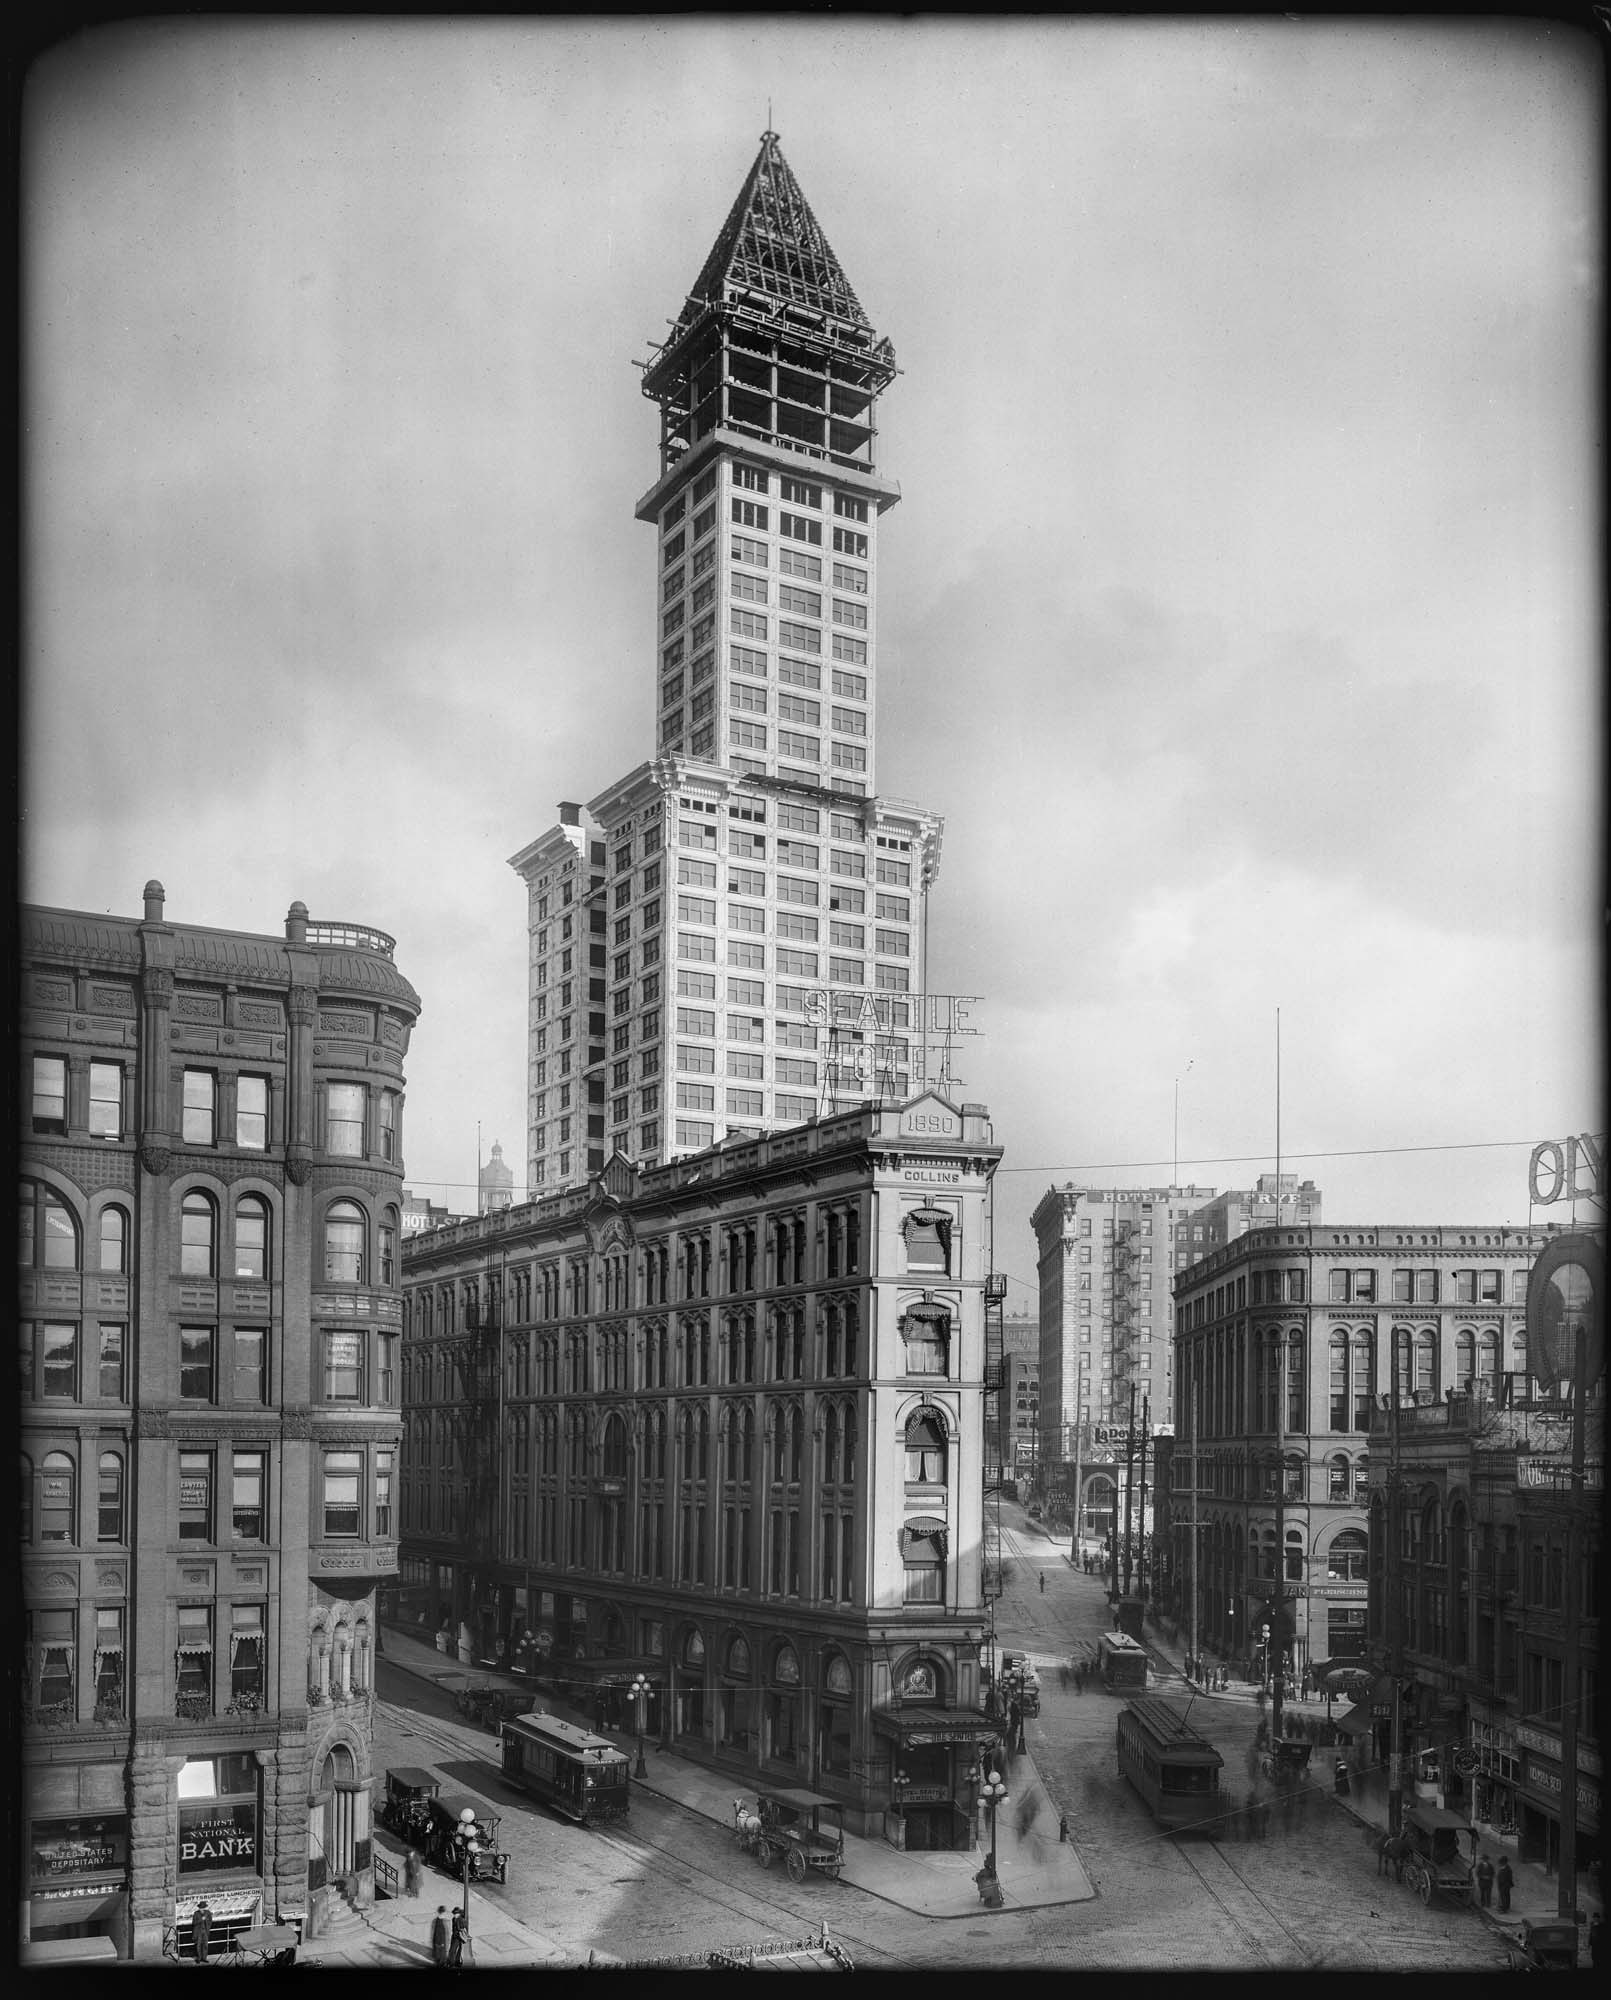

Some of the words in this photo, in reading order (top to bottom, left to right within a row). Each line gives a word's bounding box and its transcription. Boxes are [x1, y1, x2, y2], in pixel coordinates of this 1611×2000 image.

[804, 990, 977, 1034] SEATTLE
[821, 1046, 961, 1084] HOTEL
[908, 1114, 953, 1134] 1890
[904, 1170, 959, 1183] COLLINS
[1102, 1193, 1166, 1202] HOTEL
[1242, 1193, 1301, 1204] FRYE
[201, 1818, 235, 1828] FIRST
[190, 1828, 245, 1839] NATIONAL
[45, 1850, 77, 1861] UNITED
[78, 1847, 113, 1857] STATES
[181, 1838, 253, 1860] BANK
[51, 1857, 105, 1868] DEPOSITARY
[185, 1893, 225, 1901] PITTSBURGH
[226, 1889, 260, 1897] LUNCHEON
